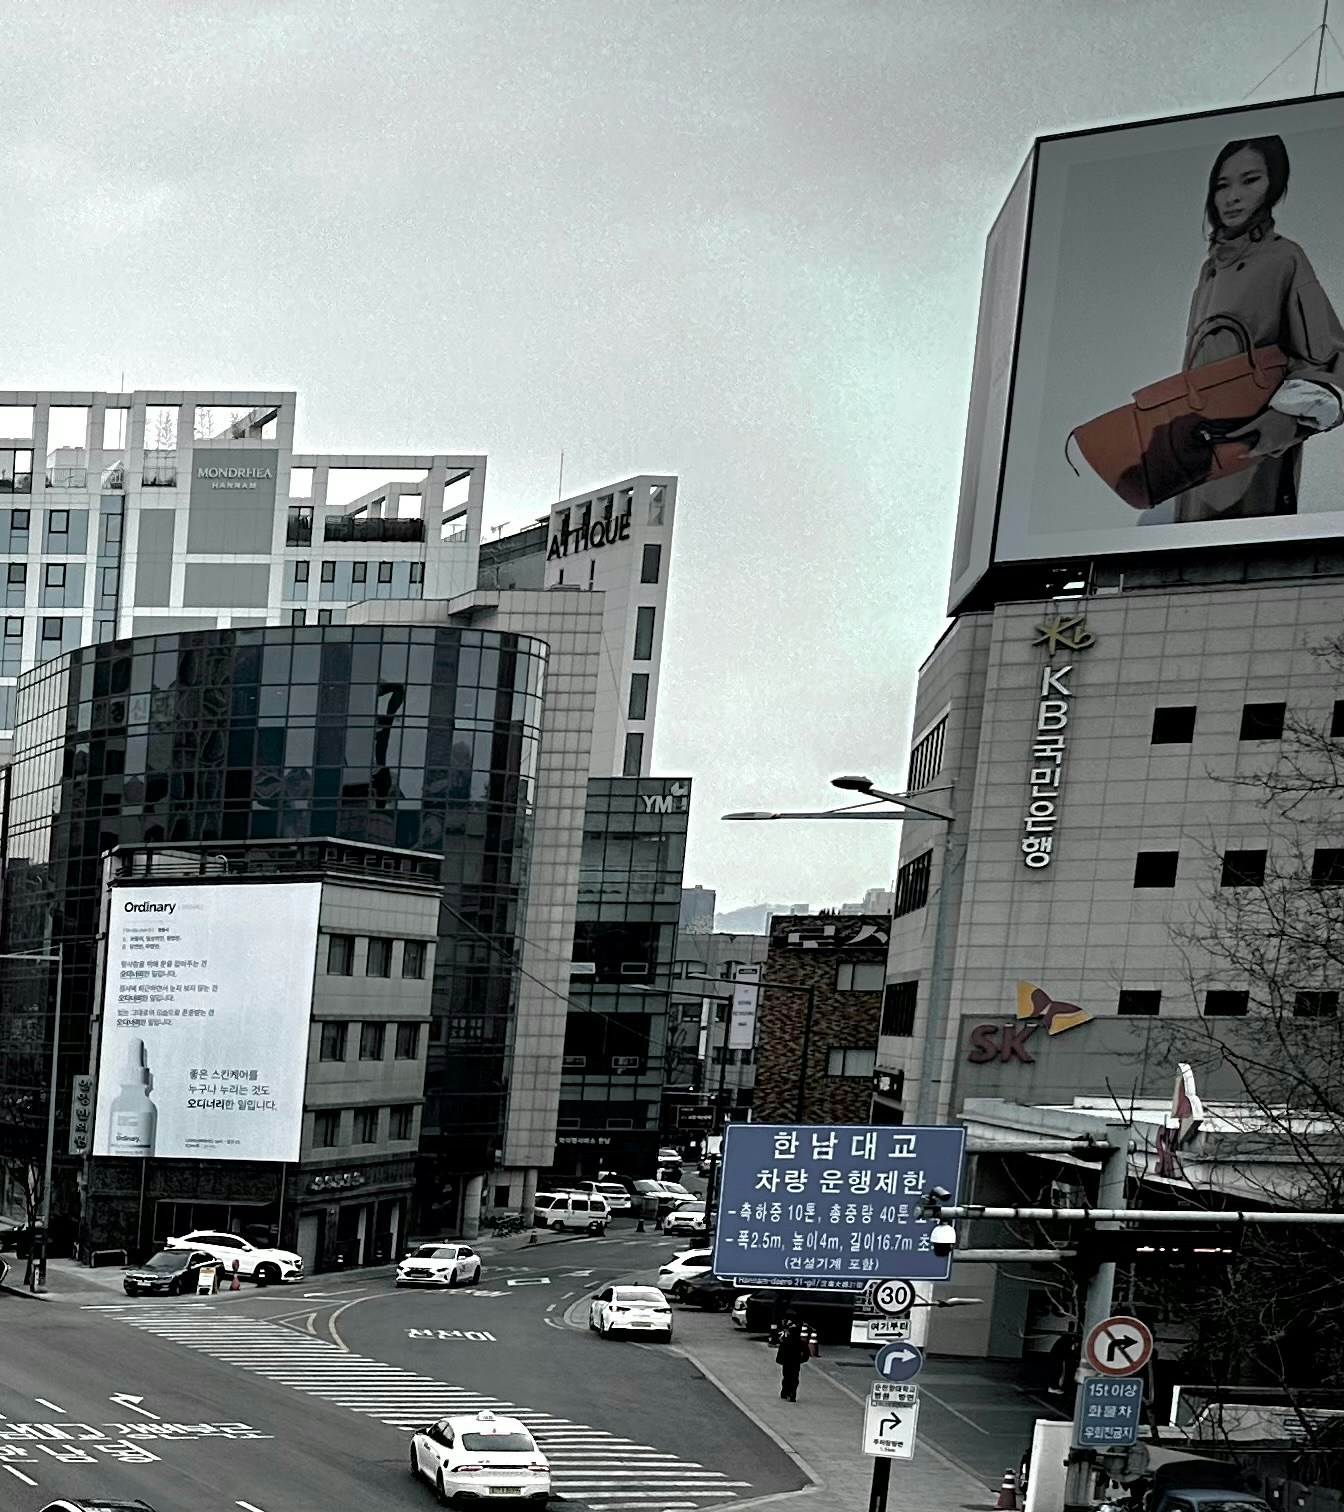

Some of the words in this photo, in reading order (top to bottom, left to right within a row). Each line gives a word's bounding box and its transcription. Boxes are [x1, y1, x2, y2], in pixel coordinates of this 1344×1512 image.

[547, 513, 630, 561] ATTIQUE
[1022, 665, 1072, 869] KB국민은행
[124, 901, 176, 914] Ordinary
[968, 1024, 1036, 1064] SK
[190, 1069, 208, 1080] 좋은
[212, 1069, 258, 1081] 스킨케어를
[188, 1084, 216, 1095] 누구나
[219, 1084, 248, 1095] 누리는
[252, 1085, 270, 1095] 것도
[187, 1099, 234, 1110] 오디너리한
[238, 1100, 277, 1110] 일입니다.
[773, 1130, 918, 1161] 한남대교
[755, 1168, 808, 1193] 차량
[819, 1169, 926, 1195] 운행제한
[788, 1202, 822, 1224] 10톤,
[829, 1203, 873, 1224] 총중량
[879, 1205, 909, 1225] 40톤
[792, 1230, 843, 1252] 높이4m,
[850, 1231, 912, 1252] 길이16.7m
[784, 1257, 842, 1271] (건설기계
[848, 1257, 879, 1271] 포함)
[880, 1286, 908, 1305] 30
[871, 1321, 909, 1330] 여기부터
[1088, 1383, 1109, 1397] 15t
[1111, 1384, 1138, 1398] 이상
[1088, 1405, 1132, 1419] 화물차
[1084, 1426, 1133, 1439] 우회전금지
